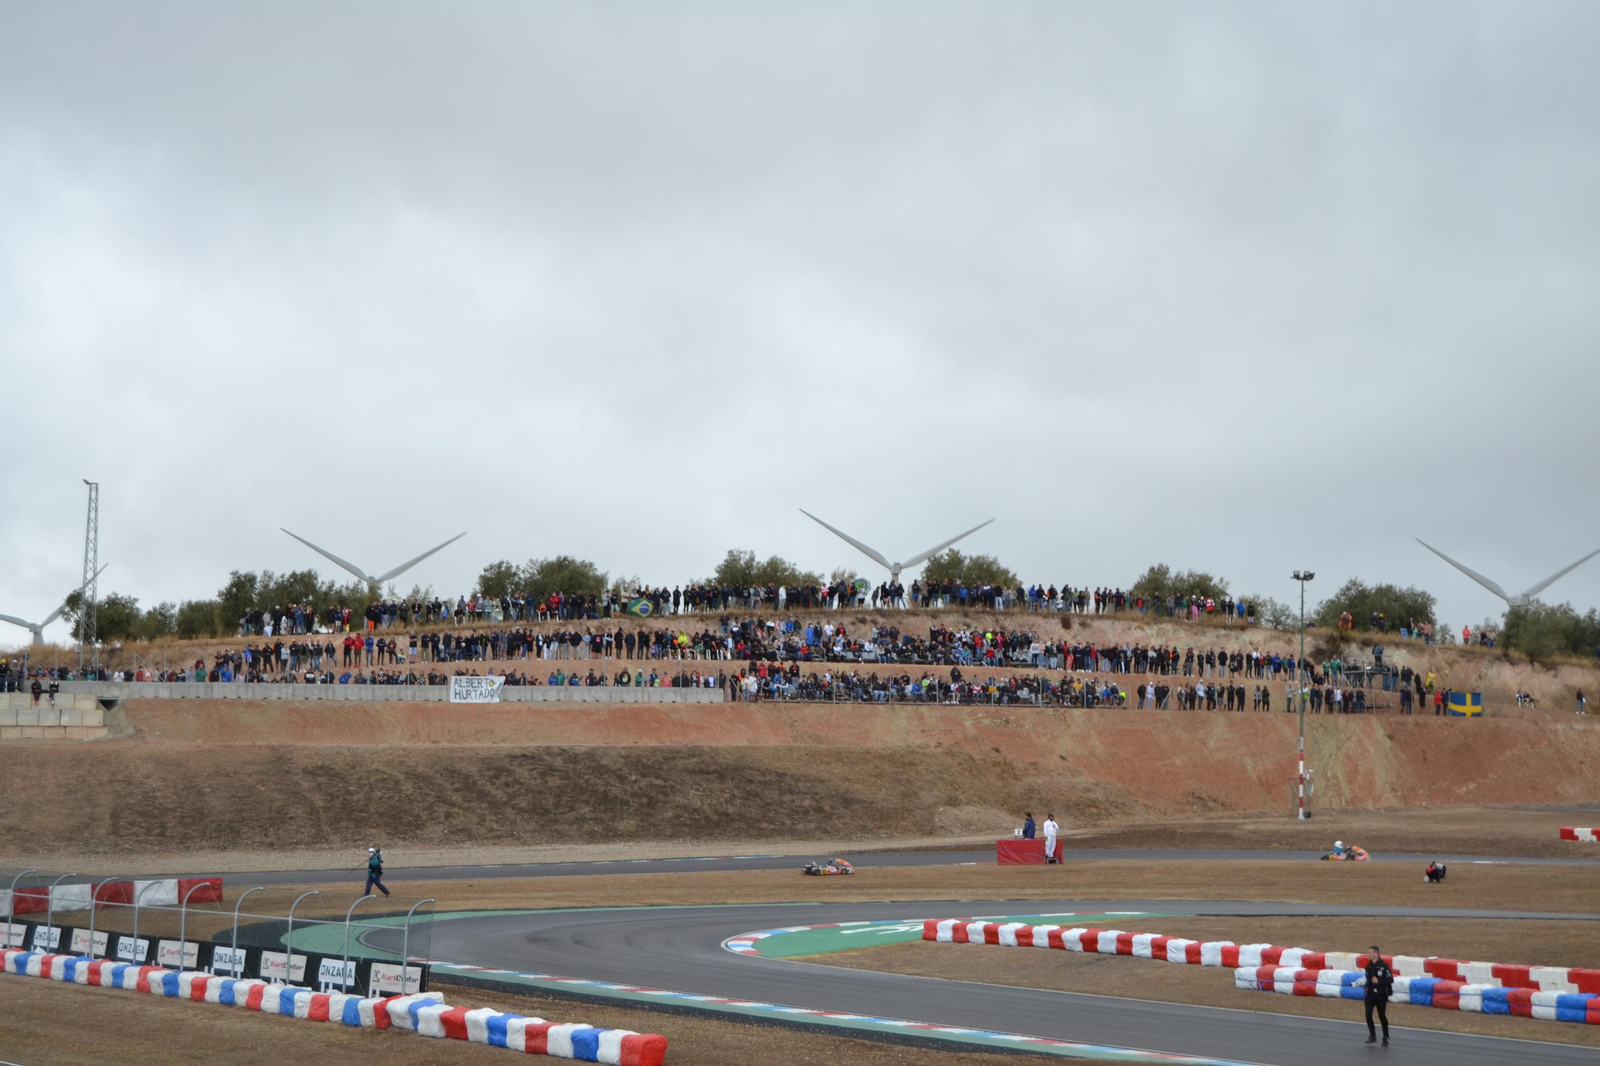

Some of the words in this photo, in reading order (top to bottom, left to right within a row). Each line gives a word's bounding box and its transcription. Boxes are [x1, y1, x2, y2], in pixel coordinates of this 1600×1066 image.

[454, 678, 495, 689] ALBERTO
[454, 688, 495, 700] HURTADO
[35, 931, 58, 942] ONZGA
[80, 937, 106, 946] Kartenter
[119, 942, 145, 956] ONZGA
